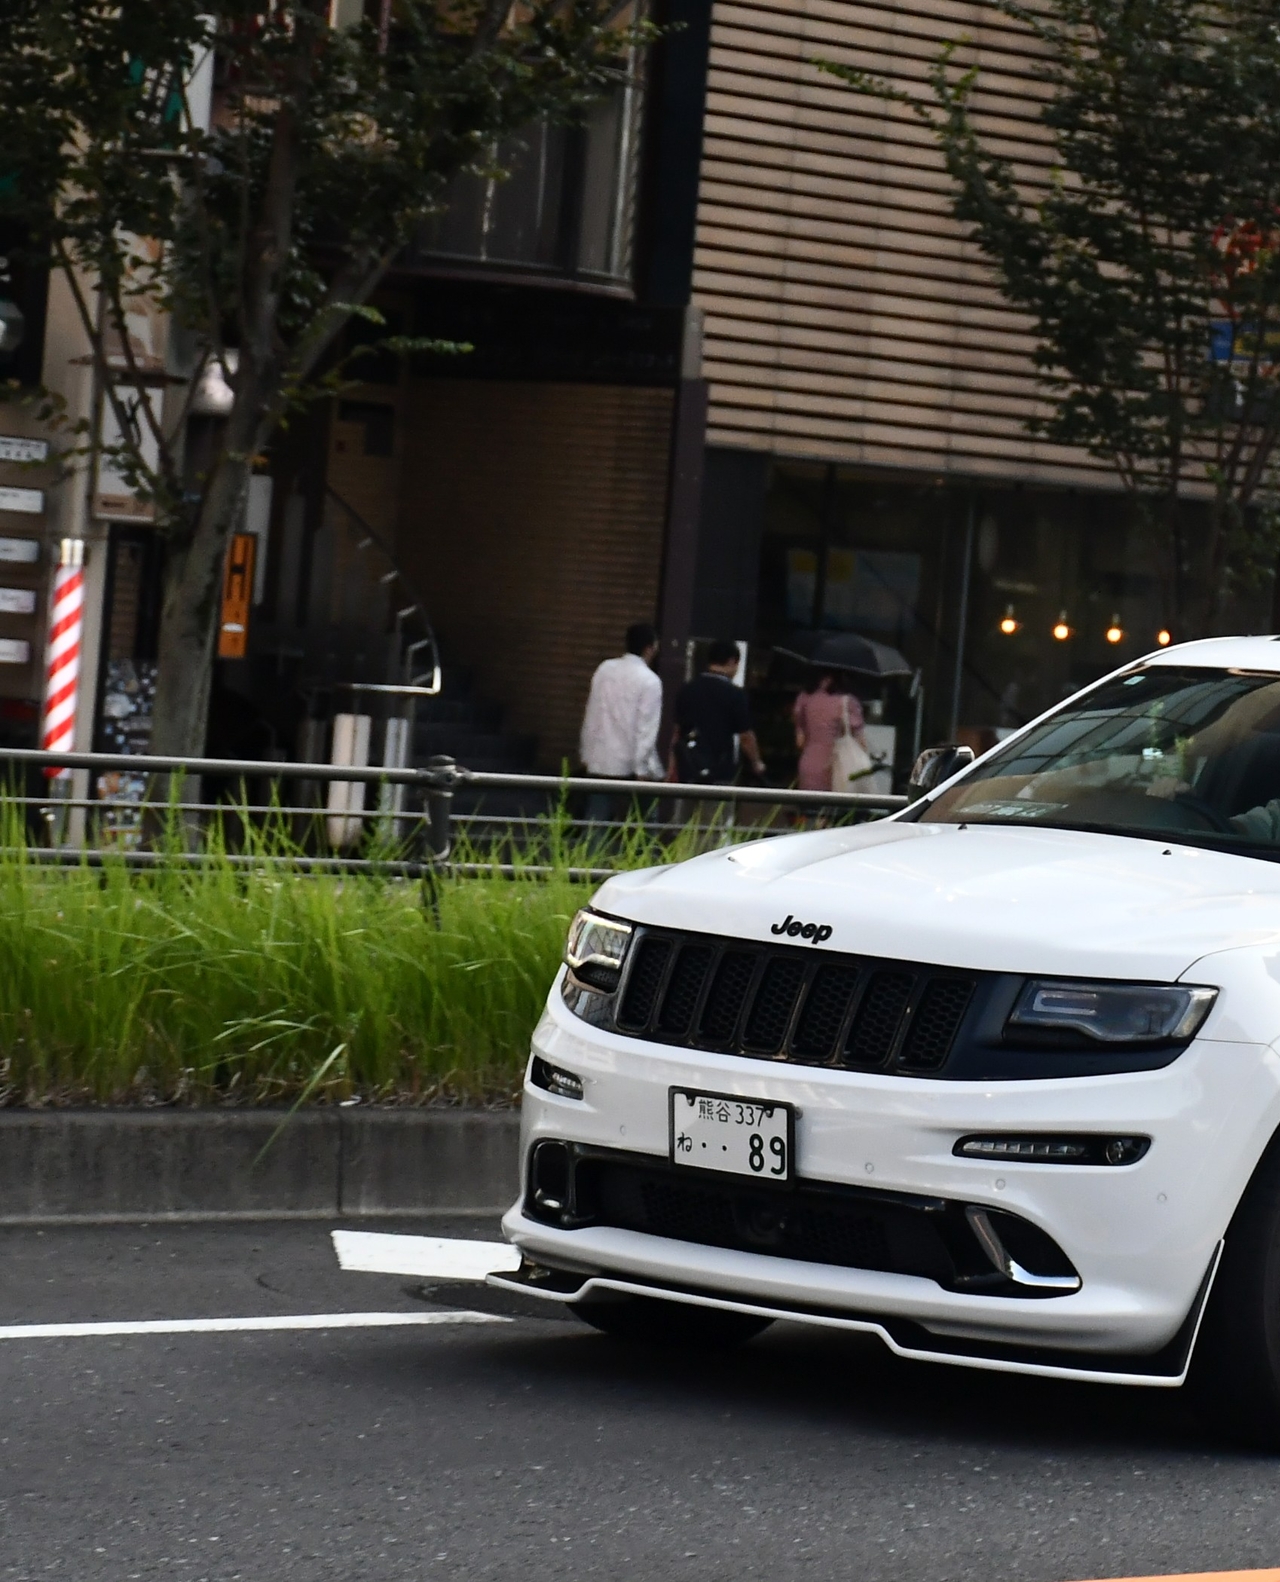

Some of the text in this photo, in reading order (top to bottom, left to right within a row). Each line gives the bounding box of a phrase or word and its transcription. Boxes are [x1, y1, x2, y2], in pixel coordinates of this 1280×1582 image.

[770, 914, 833, 945] Jeep
[698, 1098, 765, 1127] 熊谷 337
[676, 1131, 693, 1153] ね
[748, 1133, 786, 1175] 89
